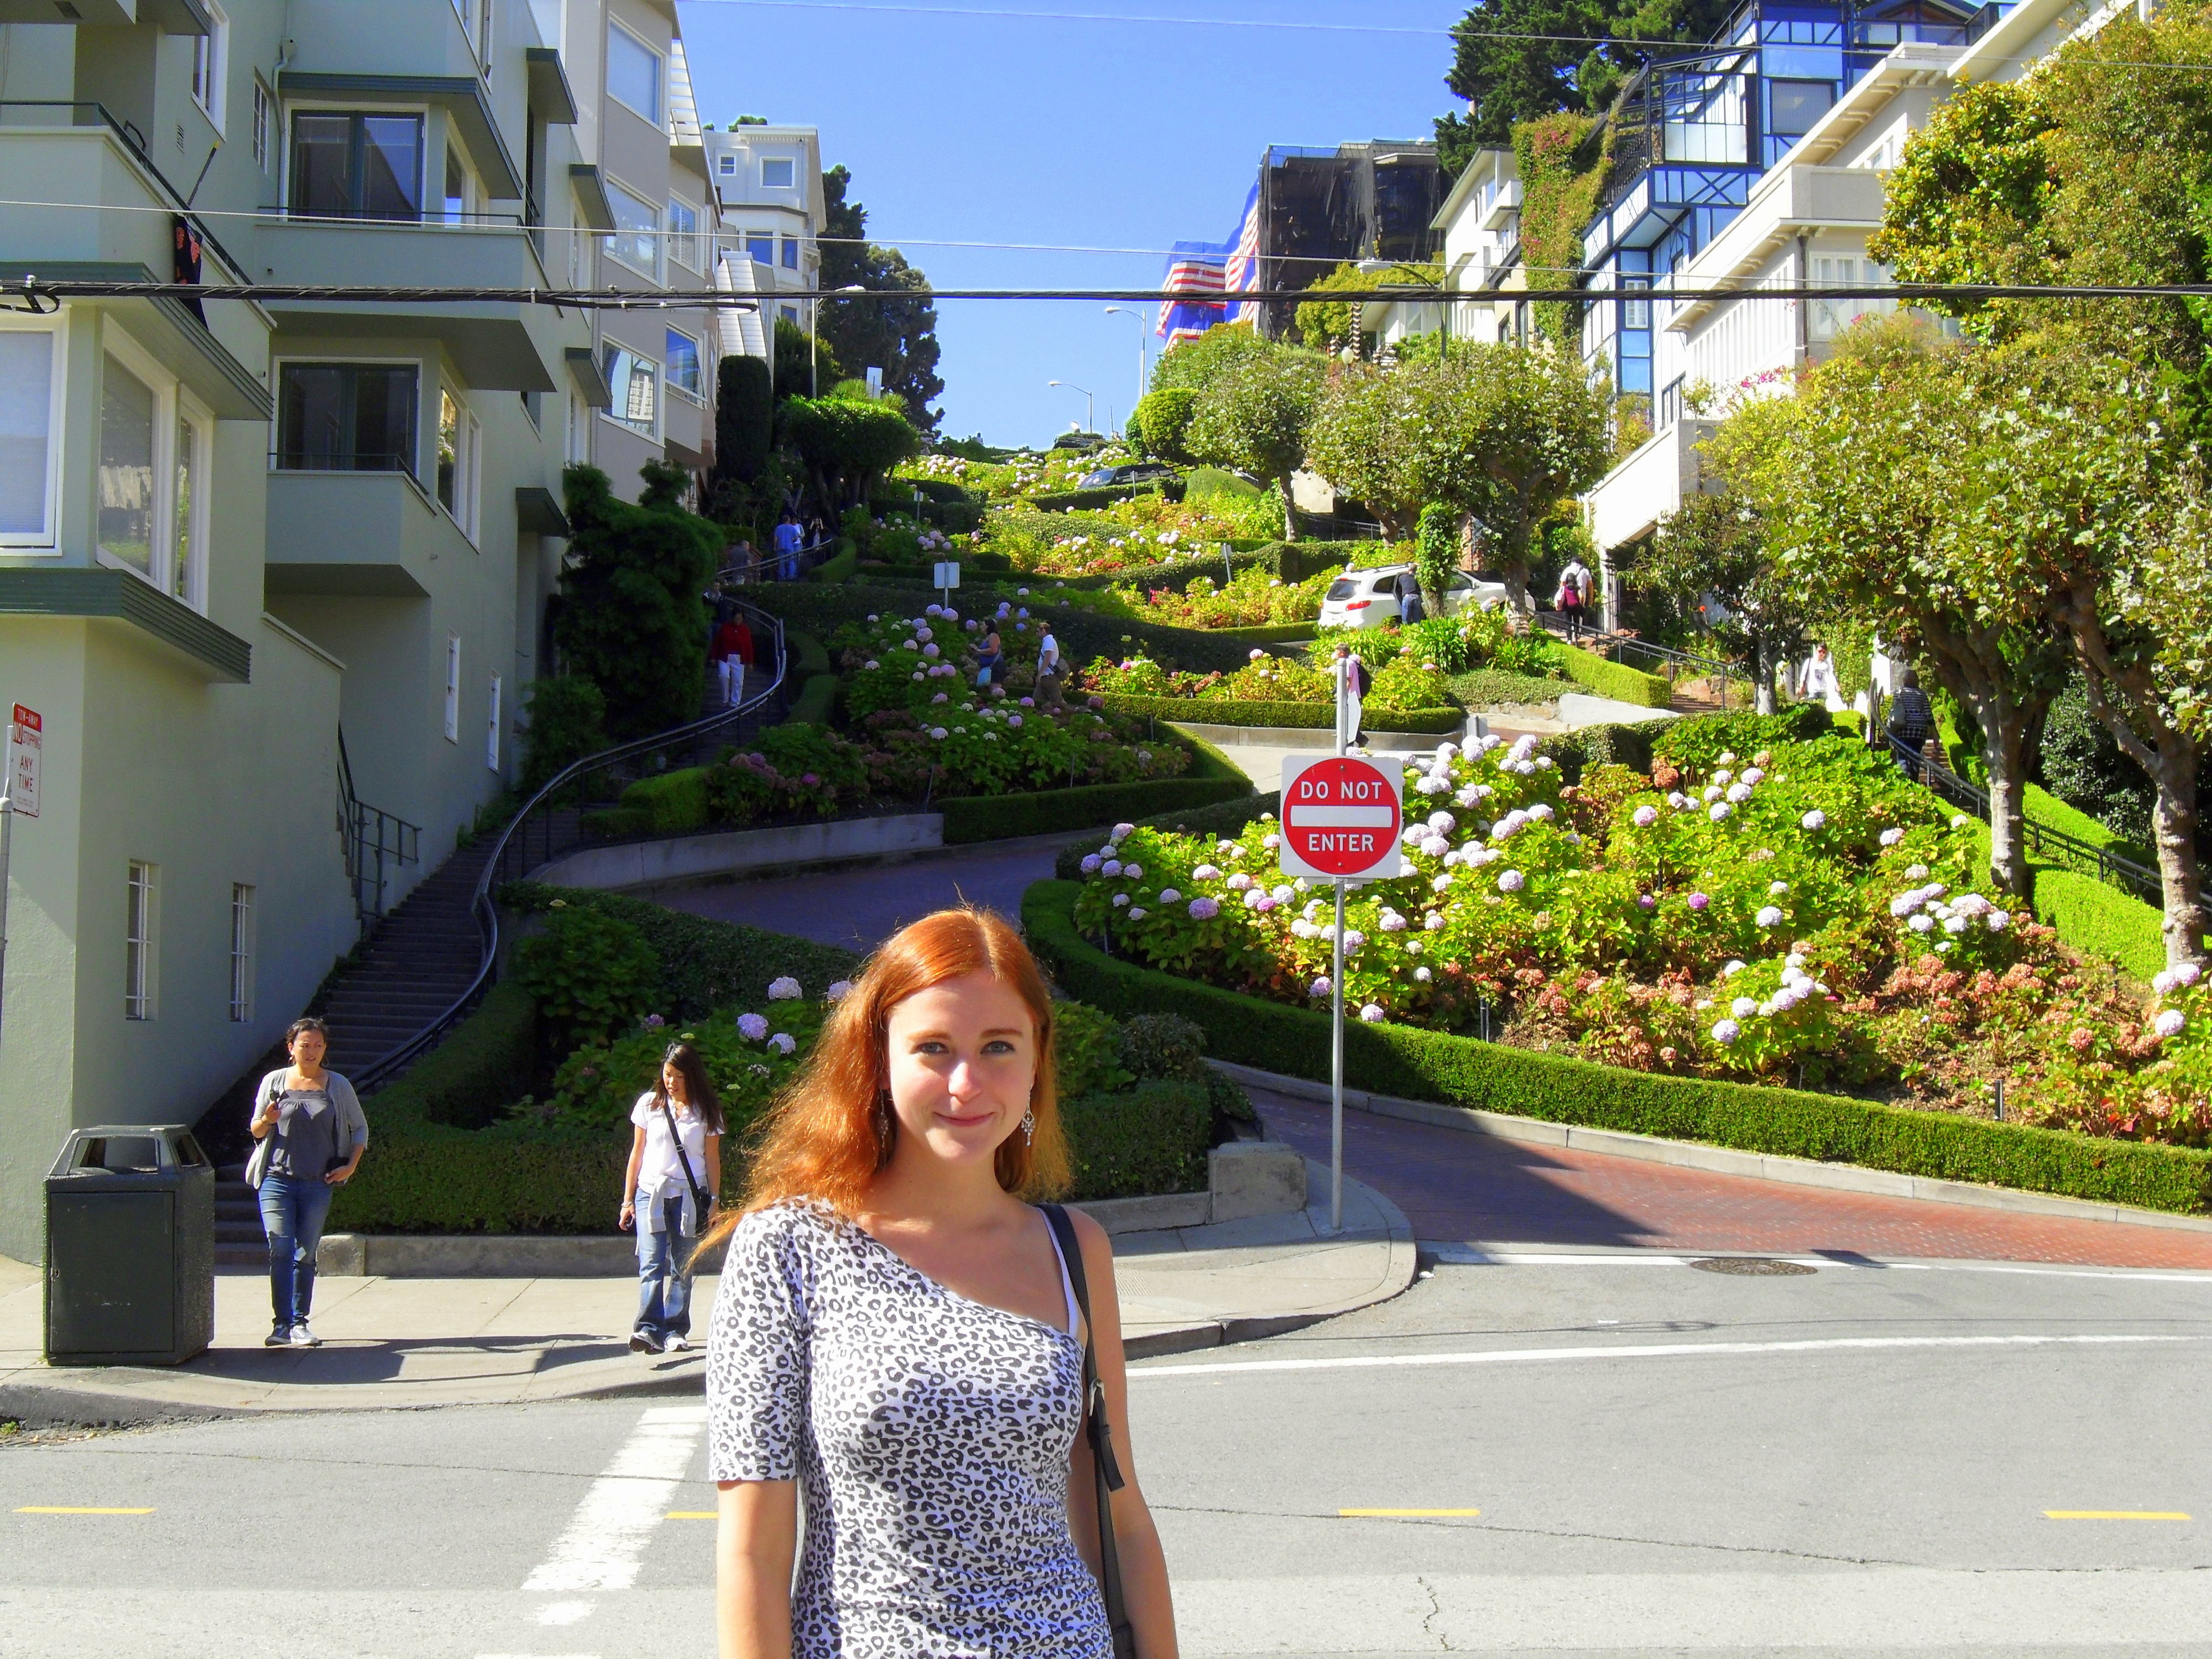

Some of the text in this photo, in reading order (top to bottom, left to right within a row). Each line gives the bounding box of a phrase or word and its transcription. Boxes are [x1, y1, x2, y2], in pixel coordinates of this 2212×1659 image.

[20, 755, 33, 773] ANY
[19, 774, 33, 792] TIME
[1301, 781, 1383, 800] DO NOT
[1308, 833, 1374, 852] ENTER
